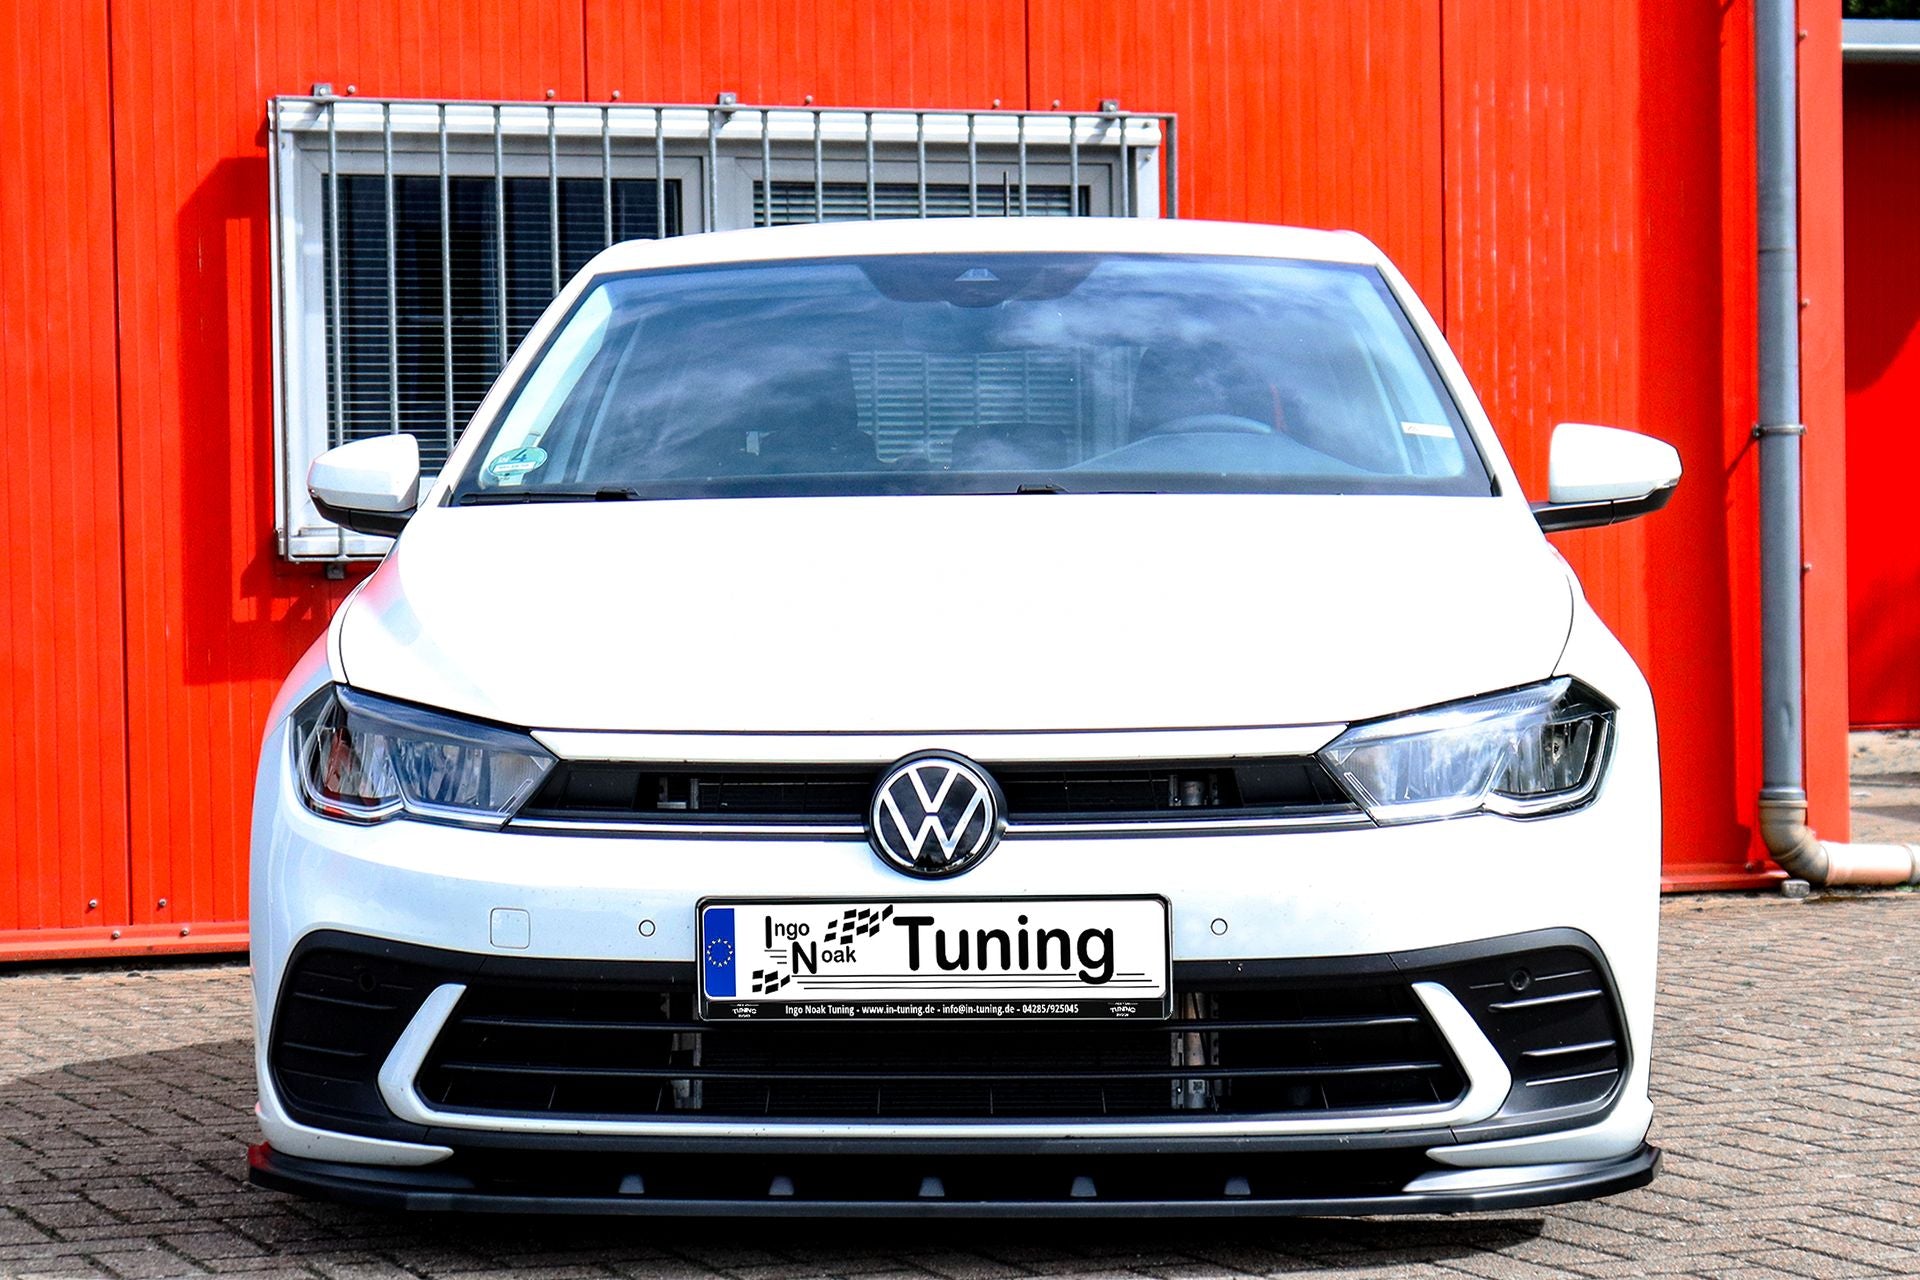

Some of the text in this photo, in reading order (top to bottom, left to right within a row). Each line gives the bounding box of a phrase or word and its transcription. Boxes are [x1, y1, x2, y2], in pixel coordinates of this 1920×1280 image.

[511, 448, 528, 462] 4
[879, 764, 988, 866] VW
[765, 915, 810, 949] Ingo
[791, 941, 857, 975] Noak
[892, 915, 1114, 985] Tuning
[785, 1004, 803, 1017] Ingo
[804, 1004, 826, 1015] Noak
[828, 1004, 854, 1017] Tuning
[861, 1004, 935, 1016] www.in-tuning.de
[942, 1004, 1015, 1016] info@in-tuning.de
[1022, 1004, 1079, 1015] 04285/925045
